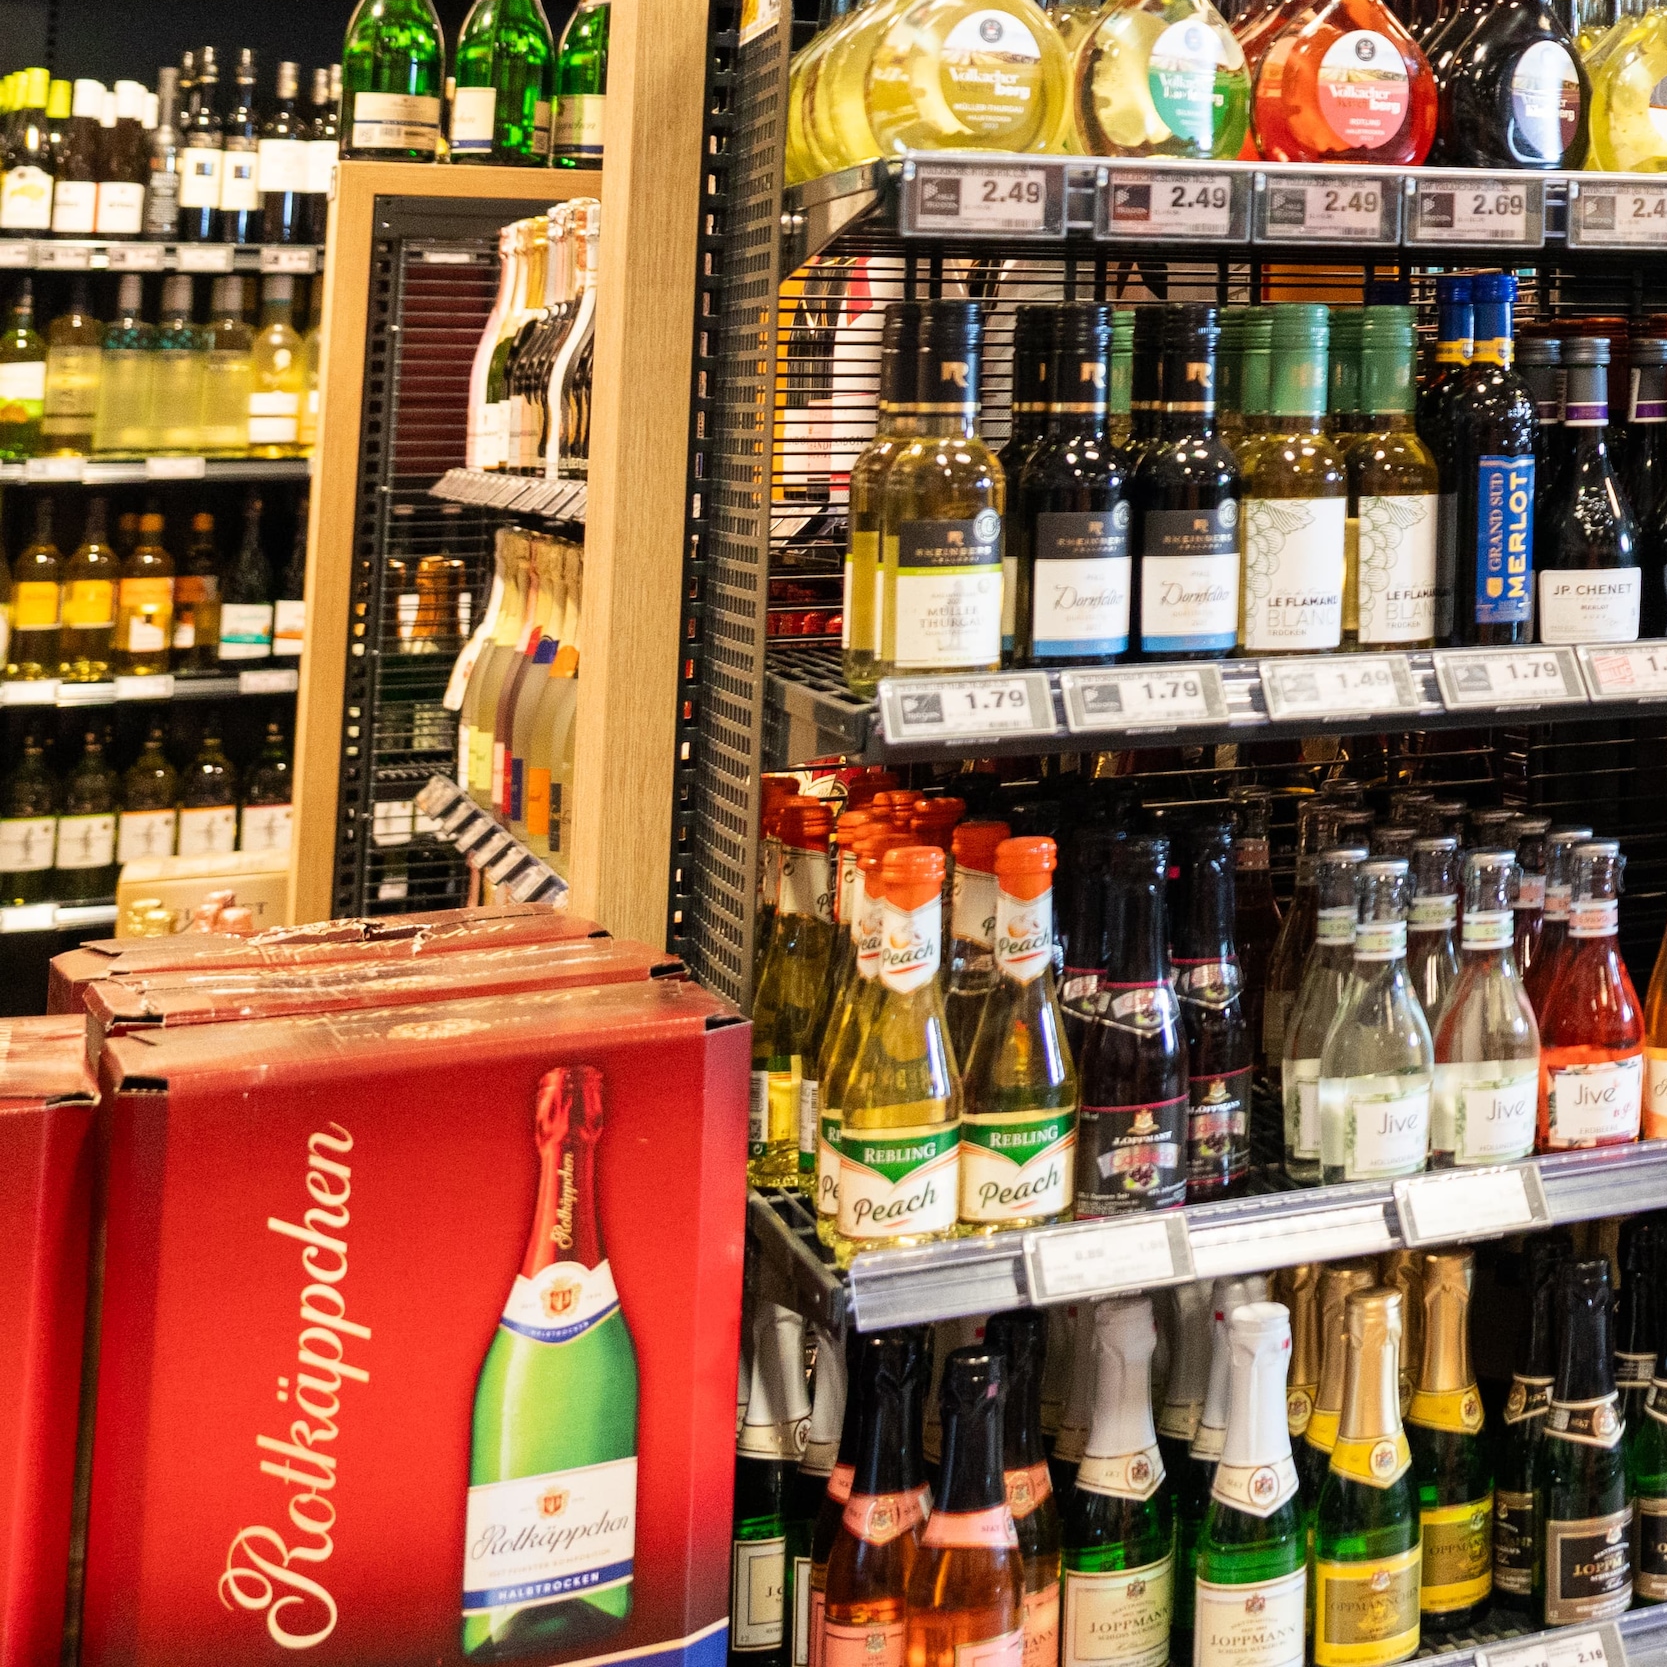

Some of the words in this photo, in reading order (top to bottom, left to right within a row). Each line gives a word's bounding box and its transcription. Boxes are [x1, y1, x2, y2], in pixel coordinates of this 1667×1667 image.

[949, 66, 1021, 86] Volkacher
[994, 84, 1031, 101] berg
[1327, 84, 1391, 101] Volkacher
[1369, 97, 1402, 114] berg
[981, 179, 1043, 205] 2.49
[1171, 185, 1227, 210] 2.49
[1324, 190, 1381, 214] 2.49
[1471, 193, 1525, 216] 2.69
[1487, 472, 1504, 507] SUD
[1487, 511, 1504, 569] GRAND
[1508, 470, 1529, 596] MERLOT
[1268, 596, 1281, 609] LE
[1284, 594, 1338, 608] FLAMAND
[1267, 609, 1338, 628] BLANC
[1506, 661, 1558, 680] 1.79
[966, 688, 1025, 712] 1.79
[1142, 680, 1198, 700] 1.79
[881, 938, 936, 970] Peach
[998, 930, 1054, 958] Peach
[1572, 1082, 1617, 1109] Jive
[1377, 1109, 1419, 1135] Jive
[1487, 1096, 1528, 1123] Jive
[989, 1124, 1059, 1147] REBLING
[863, 1140, 937, 1164] REBLING
[978, 1162, 1062, 1209] Peach
[553, 1151, 575, 1249] Rotkäppchen
[853, 1180, 938, 1227] Peach
[219, 1121, 372, 1650] Rotkäppchen
[471, 1509, 629, 1563] Rotkäppchen
[498, 1570, 600, 1602] HALBTROCKEN
